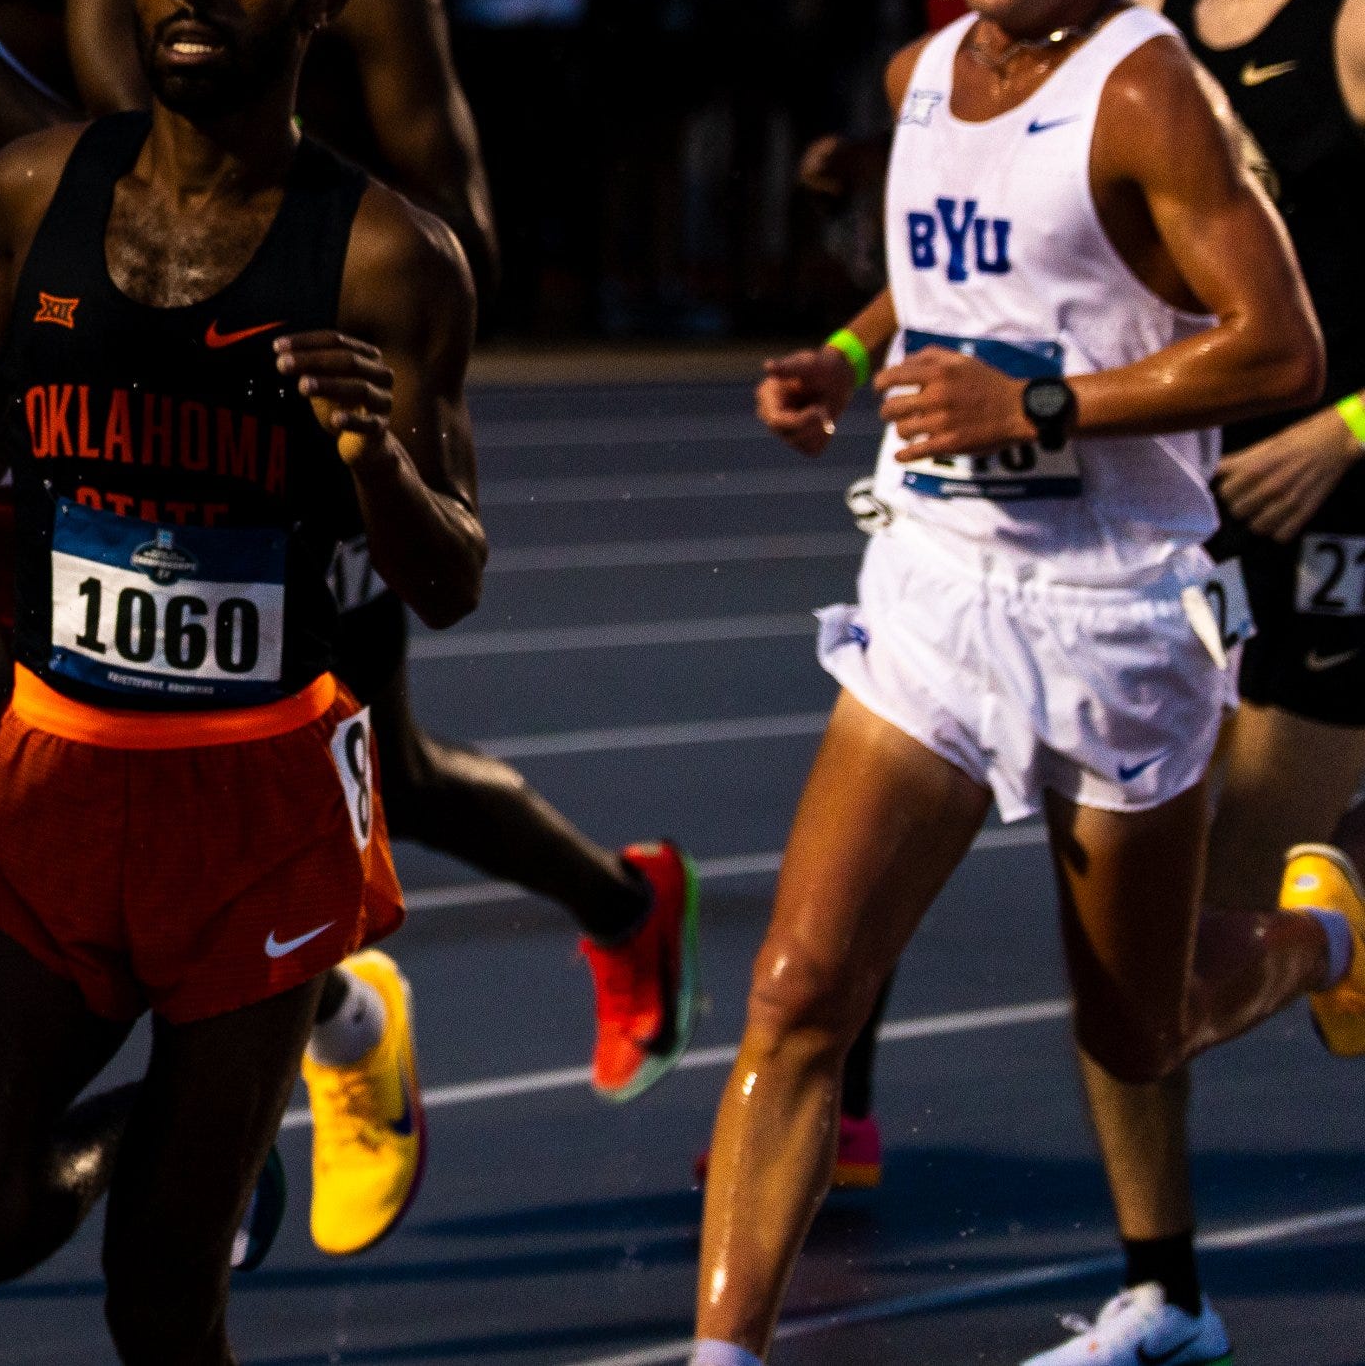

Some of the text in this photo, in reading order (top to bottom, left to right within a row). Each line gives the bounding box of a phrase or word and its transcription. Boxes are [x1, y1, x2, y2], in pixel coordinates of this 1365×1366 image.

[908, 198, 1012, 281] BYU
[23, 382, 289, 502] OKLAHOMA
[76, 577, 260, 673] 1060
